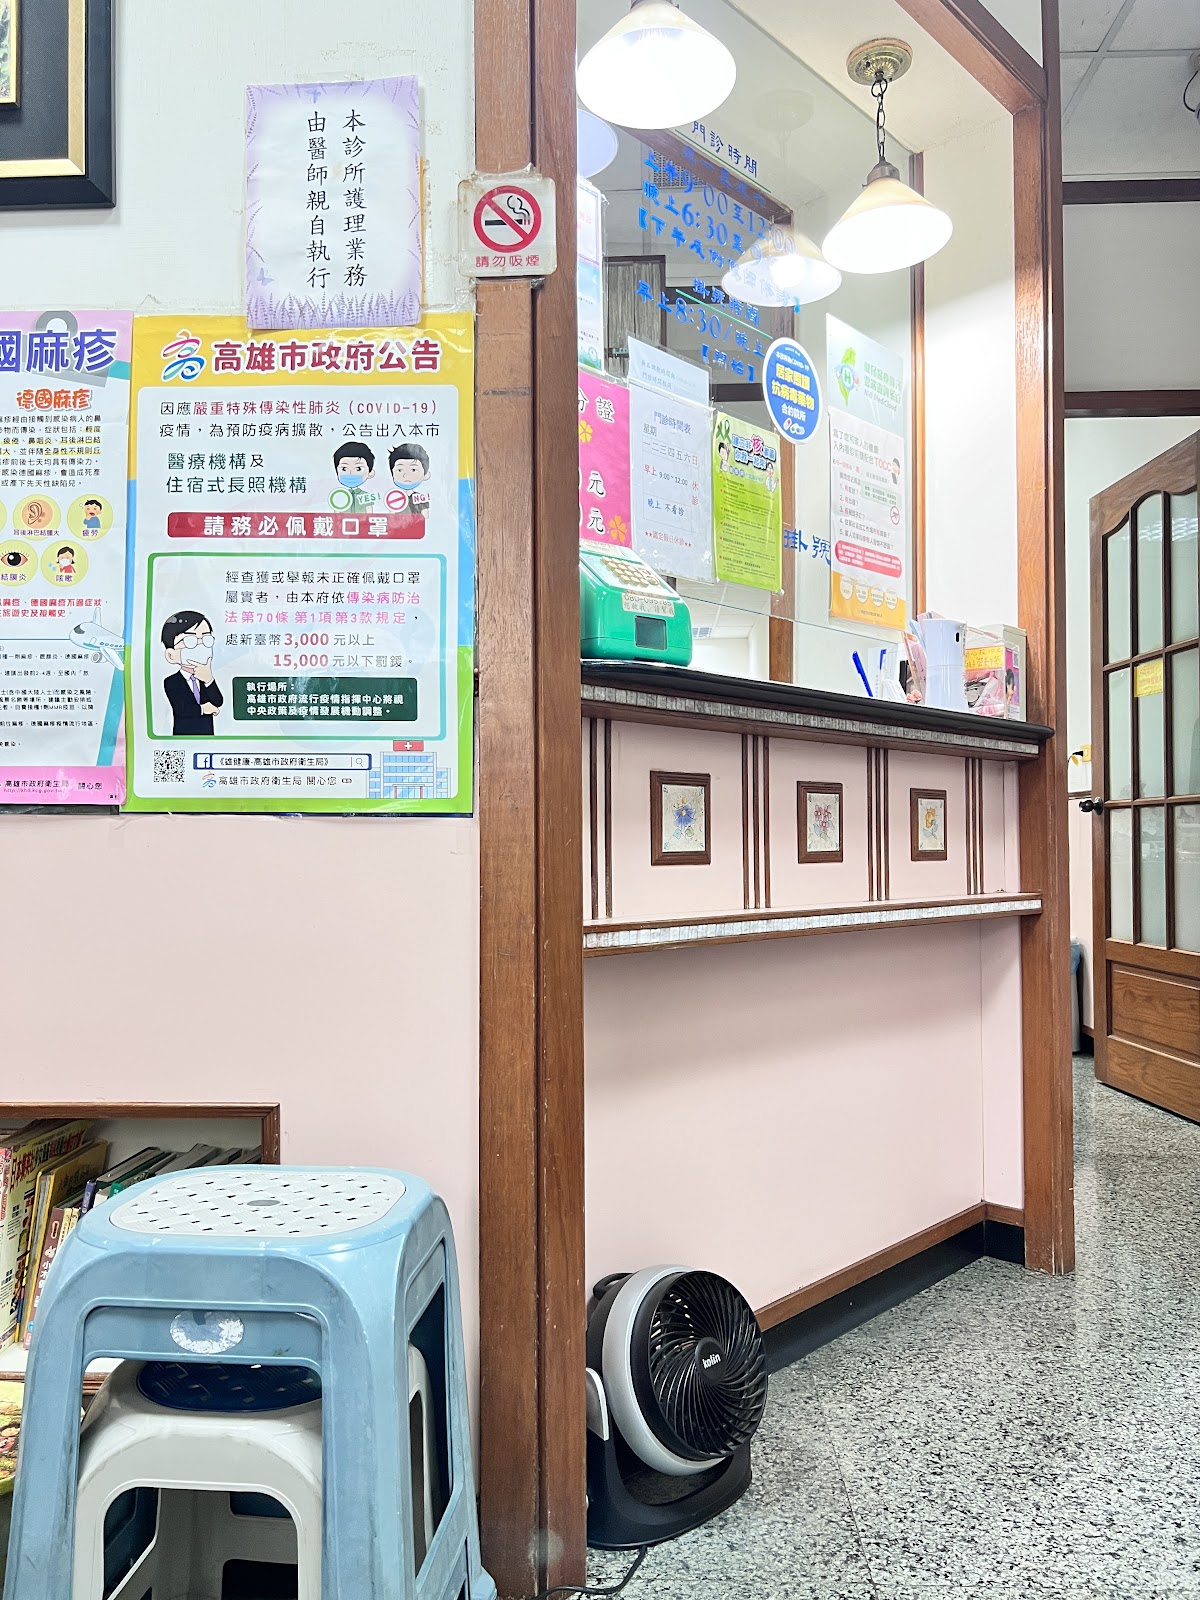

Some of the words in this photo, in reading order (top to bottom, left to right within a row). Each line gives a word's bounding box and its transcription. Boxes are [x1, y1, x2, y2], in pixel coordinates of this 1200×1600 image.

[691, 120, 758, 178] 門診時間
[306, 111, 331, 289] 由醫師親自執行
[343, 108, 368, 289] 本診所護理業務
[475, 254, 540, 268] 請勿吸煙
[692, 277, 759, 328] 掛號時間
[213, 341, 441, 373] 高雄市政府公告
[16, 388, 90, 410] 德國麻疹
[643, 423, 658, 437] 星期
[167, 452, 264, 470] 醫療機構及
[643, 464, 658, 477] 早上
[166, 475, 308, 494] 住宿式長照機構
[357, 492, 382, 504] YES!
[413, 492, 431, 503] NG!
[647, 498, 661, 511] 晚上
[665, 503, 684, 517] 不看診
[203, 515, 389, 537] 請務必佩戴口罩
[82, 529, 99, 538] 疲勞
[55, 574, 73, 583] 咳嗽
[225, 591, 421, 605] 屬實者，由本府依傳染病防治
[246, 681, 295, 692] 執行場所：
[246, 694, 404, 705] 高雄市政府流行疫情指揮中心將視
[219, 776, 302, 787] 高雄市政府衛生局
[306, 776, 337, 787] 關心您
[702, 1354, 720, 1369] kolin
